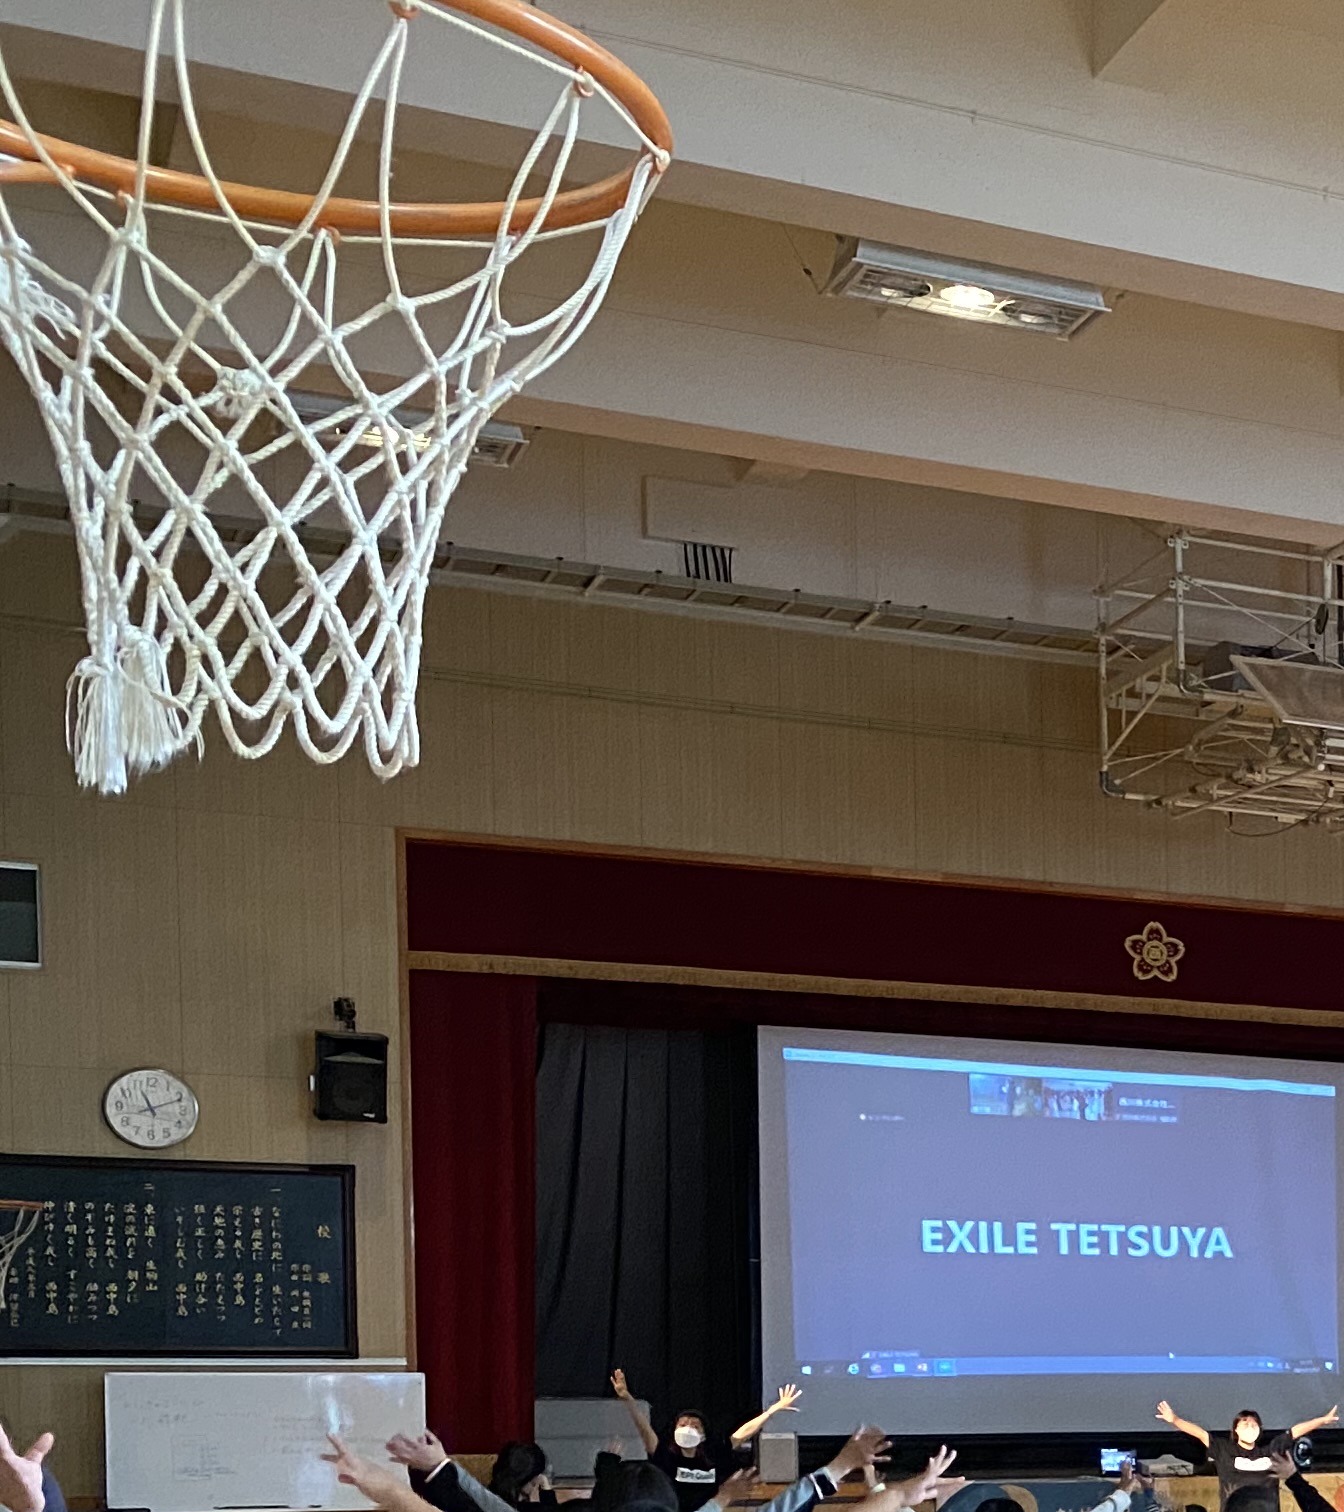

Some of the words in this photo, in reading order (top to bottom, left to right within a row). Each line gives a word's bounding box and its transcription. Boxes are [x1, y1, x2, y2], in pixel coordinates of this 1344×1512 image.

[146, 1077, 159, 1088] 12
[115, 1100, 124, 1111] 9
[178, 1105, 187, 1116] 3
[120, 1116, 129, 1127] 8
[132, 1125, 141, 1136] 7
[147, 1129, 155, 1140] 6
[162, 1127, 171, 1139] 5
[921, 1219, 1039, 1255] EXILE
[1050, 1221, 1234, 1260] TETSUYA
